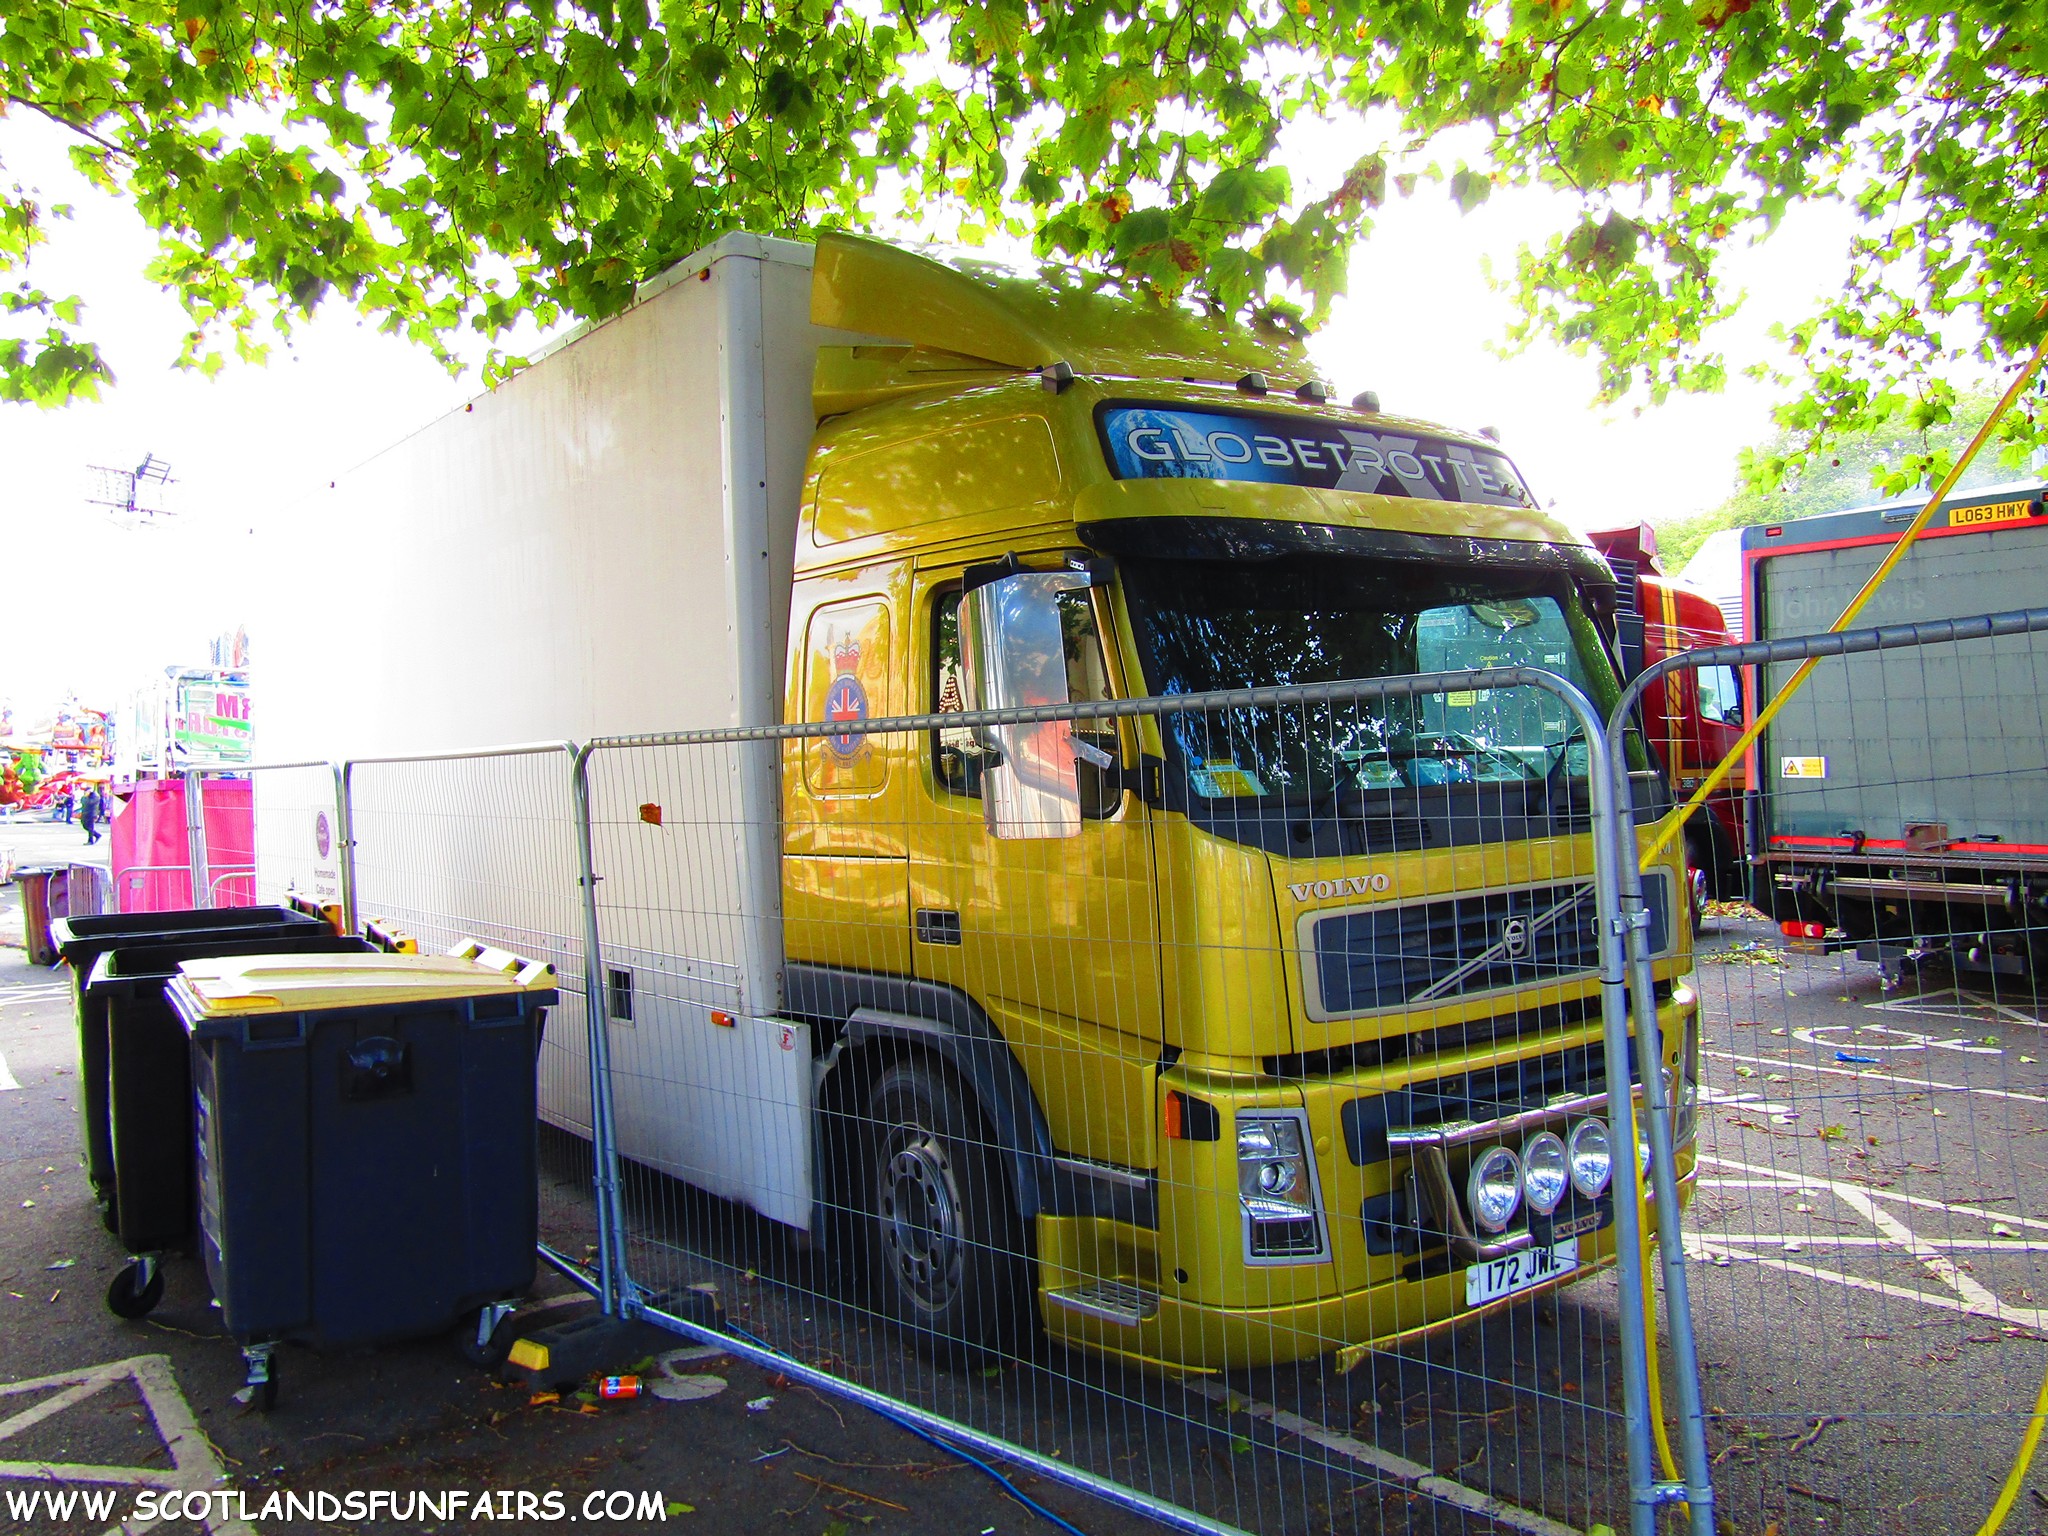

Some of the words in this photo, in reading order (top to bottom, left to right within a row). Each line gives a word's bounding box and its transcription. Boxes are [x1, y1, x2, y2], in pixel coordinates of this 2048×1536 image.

[1955, 506, 1993, 524] LO63
[1996, 502, 2026, 519] HWY
[1775, 592, 1838, 625] John
[1286, 873, 1390, 902] VOLVO
[1487, 1256, 1519, 1292] 172
